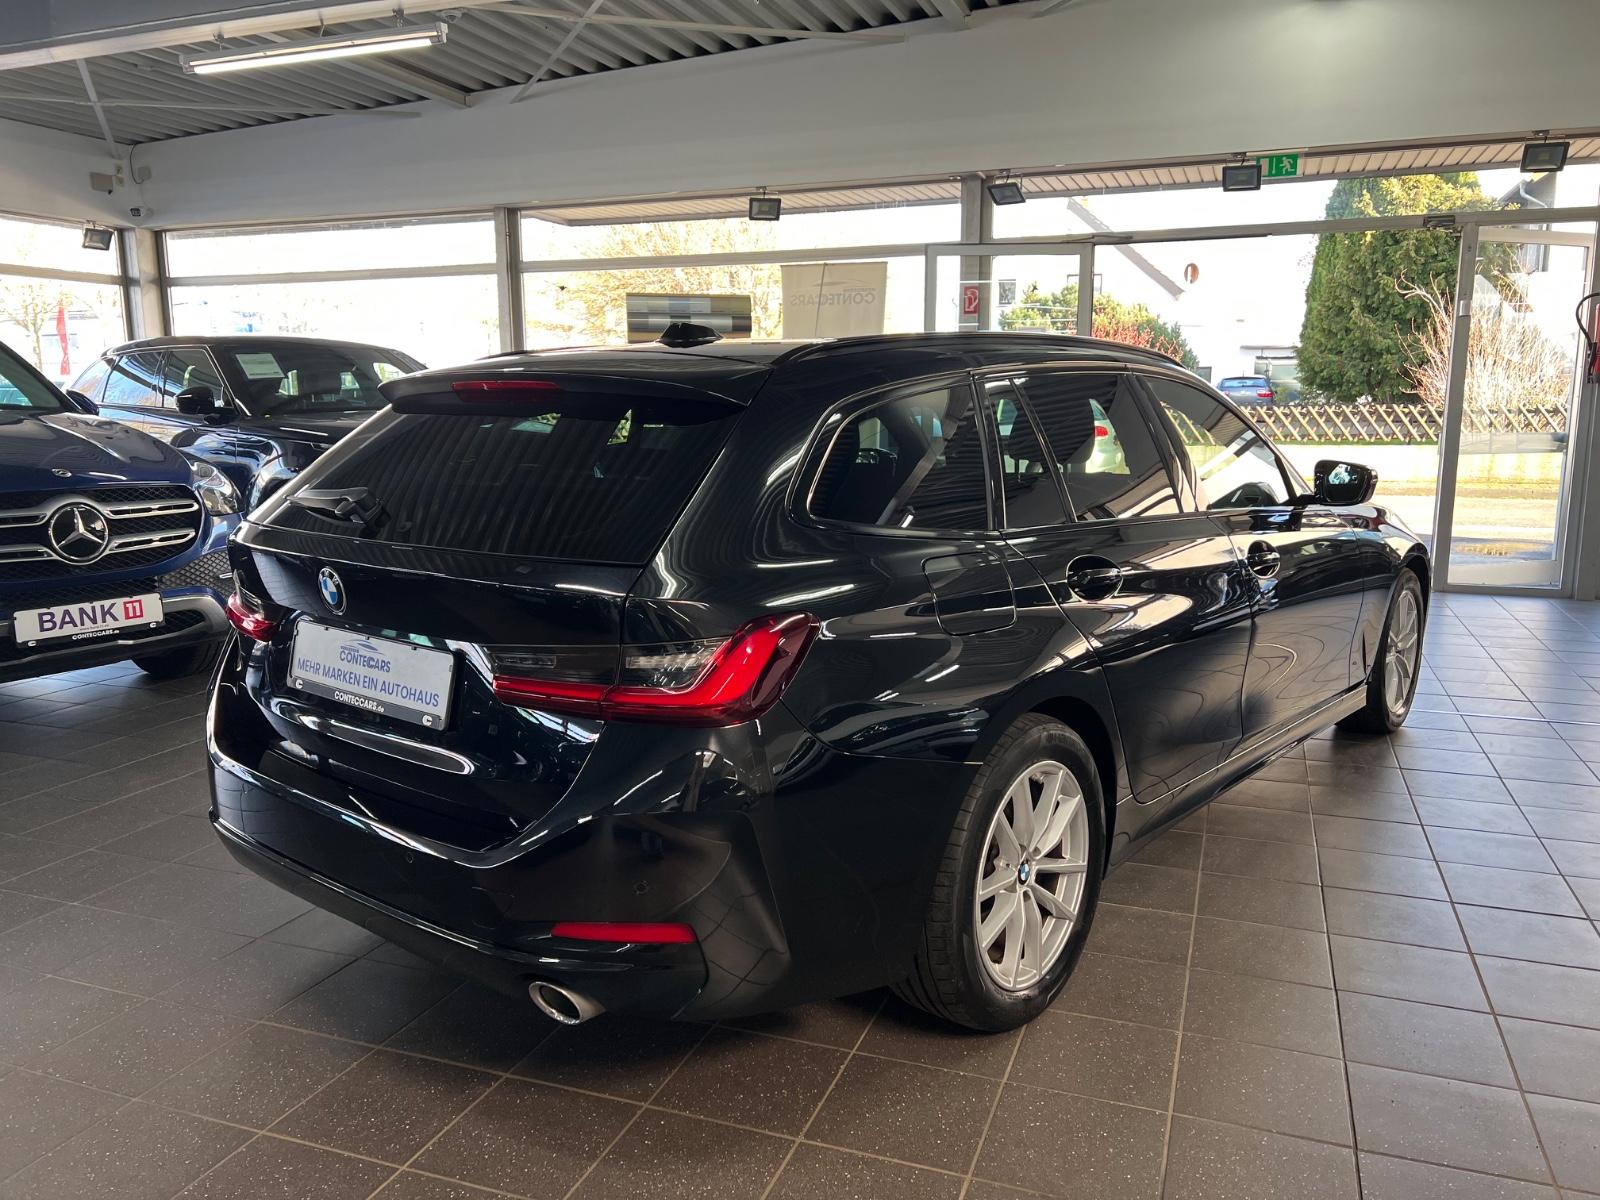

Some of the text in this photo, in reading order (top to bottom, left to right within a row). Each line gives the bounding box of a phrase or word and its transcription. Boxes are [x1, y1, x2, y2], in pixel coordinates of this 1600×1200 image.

[37, 602, 141, 633] BANK 11
[297, 657, 440, 708] MEHR MARKEN EIN AUTOHAUS
[334, 691, 385, 713] CONTECCARS.de
